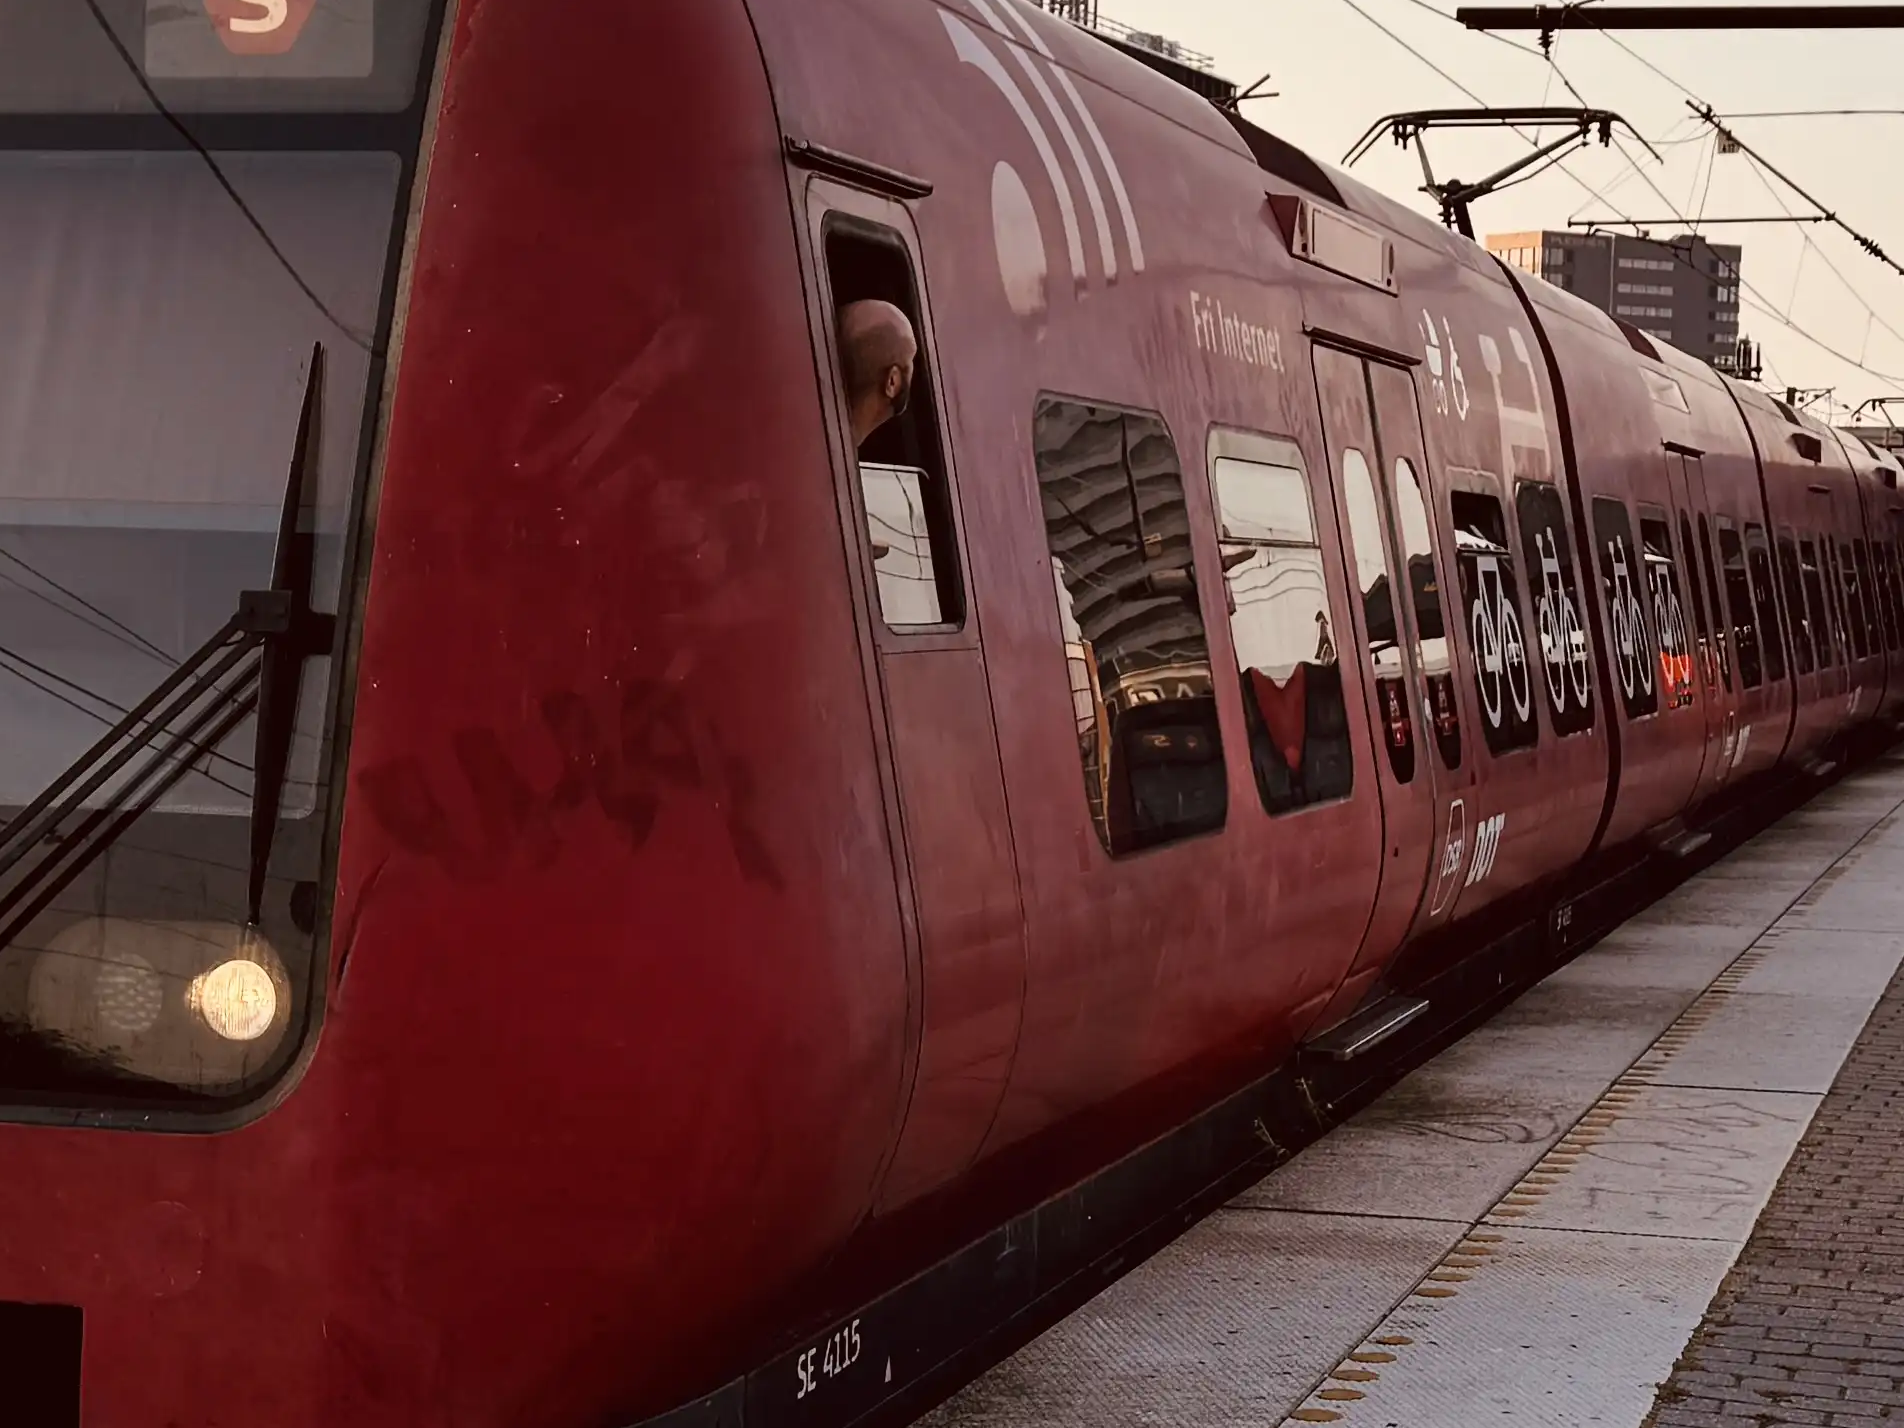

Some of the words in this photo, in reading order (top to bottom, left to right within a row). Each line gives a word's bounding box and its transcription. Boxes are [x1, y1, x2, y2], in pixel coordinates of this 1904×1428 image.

[1190, 290, 1217, 354] Fri
[1217, 299, 1285, 373] Internet
[797, 1347, 817, 1400] SE
[823, 1318, 861, 1378] 4115
